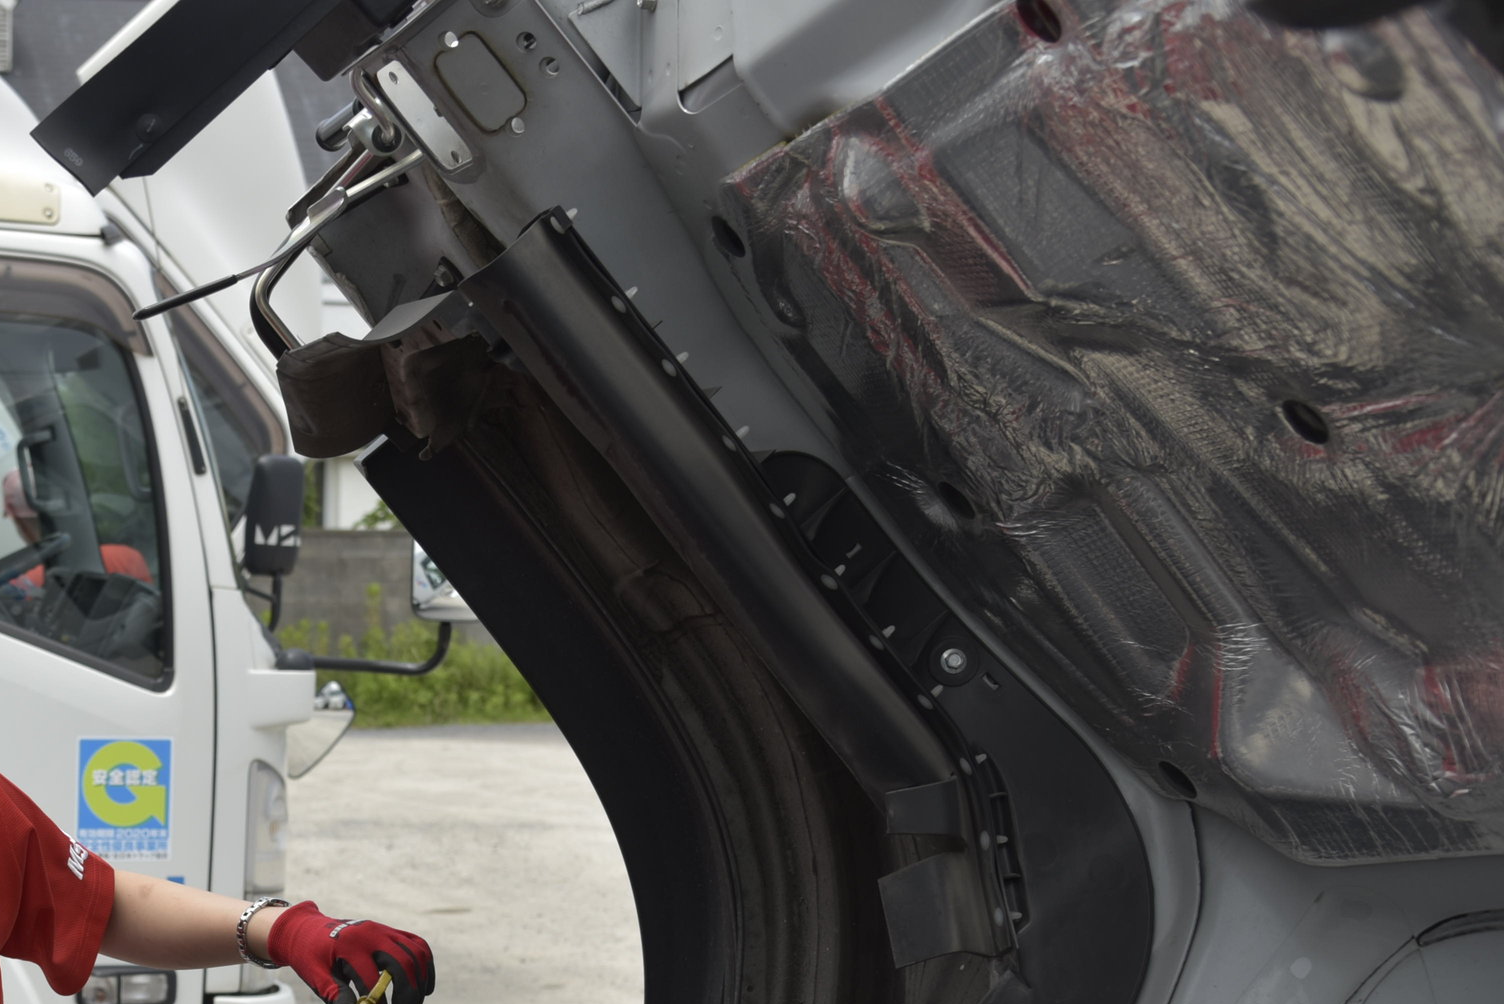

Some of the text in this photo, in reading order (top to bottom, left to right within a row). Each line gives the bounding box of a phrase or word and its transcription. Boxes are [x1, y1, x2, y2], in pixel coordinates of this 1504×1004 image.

[93, 769, 158, 786] 安全認定
[65, 834, 89, 881] MS
